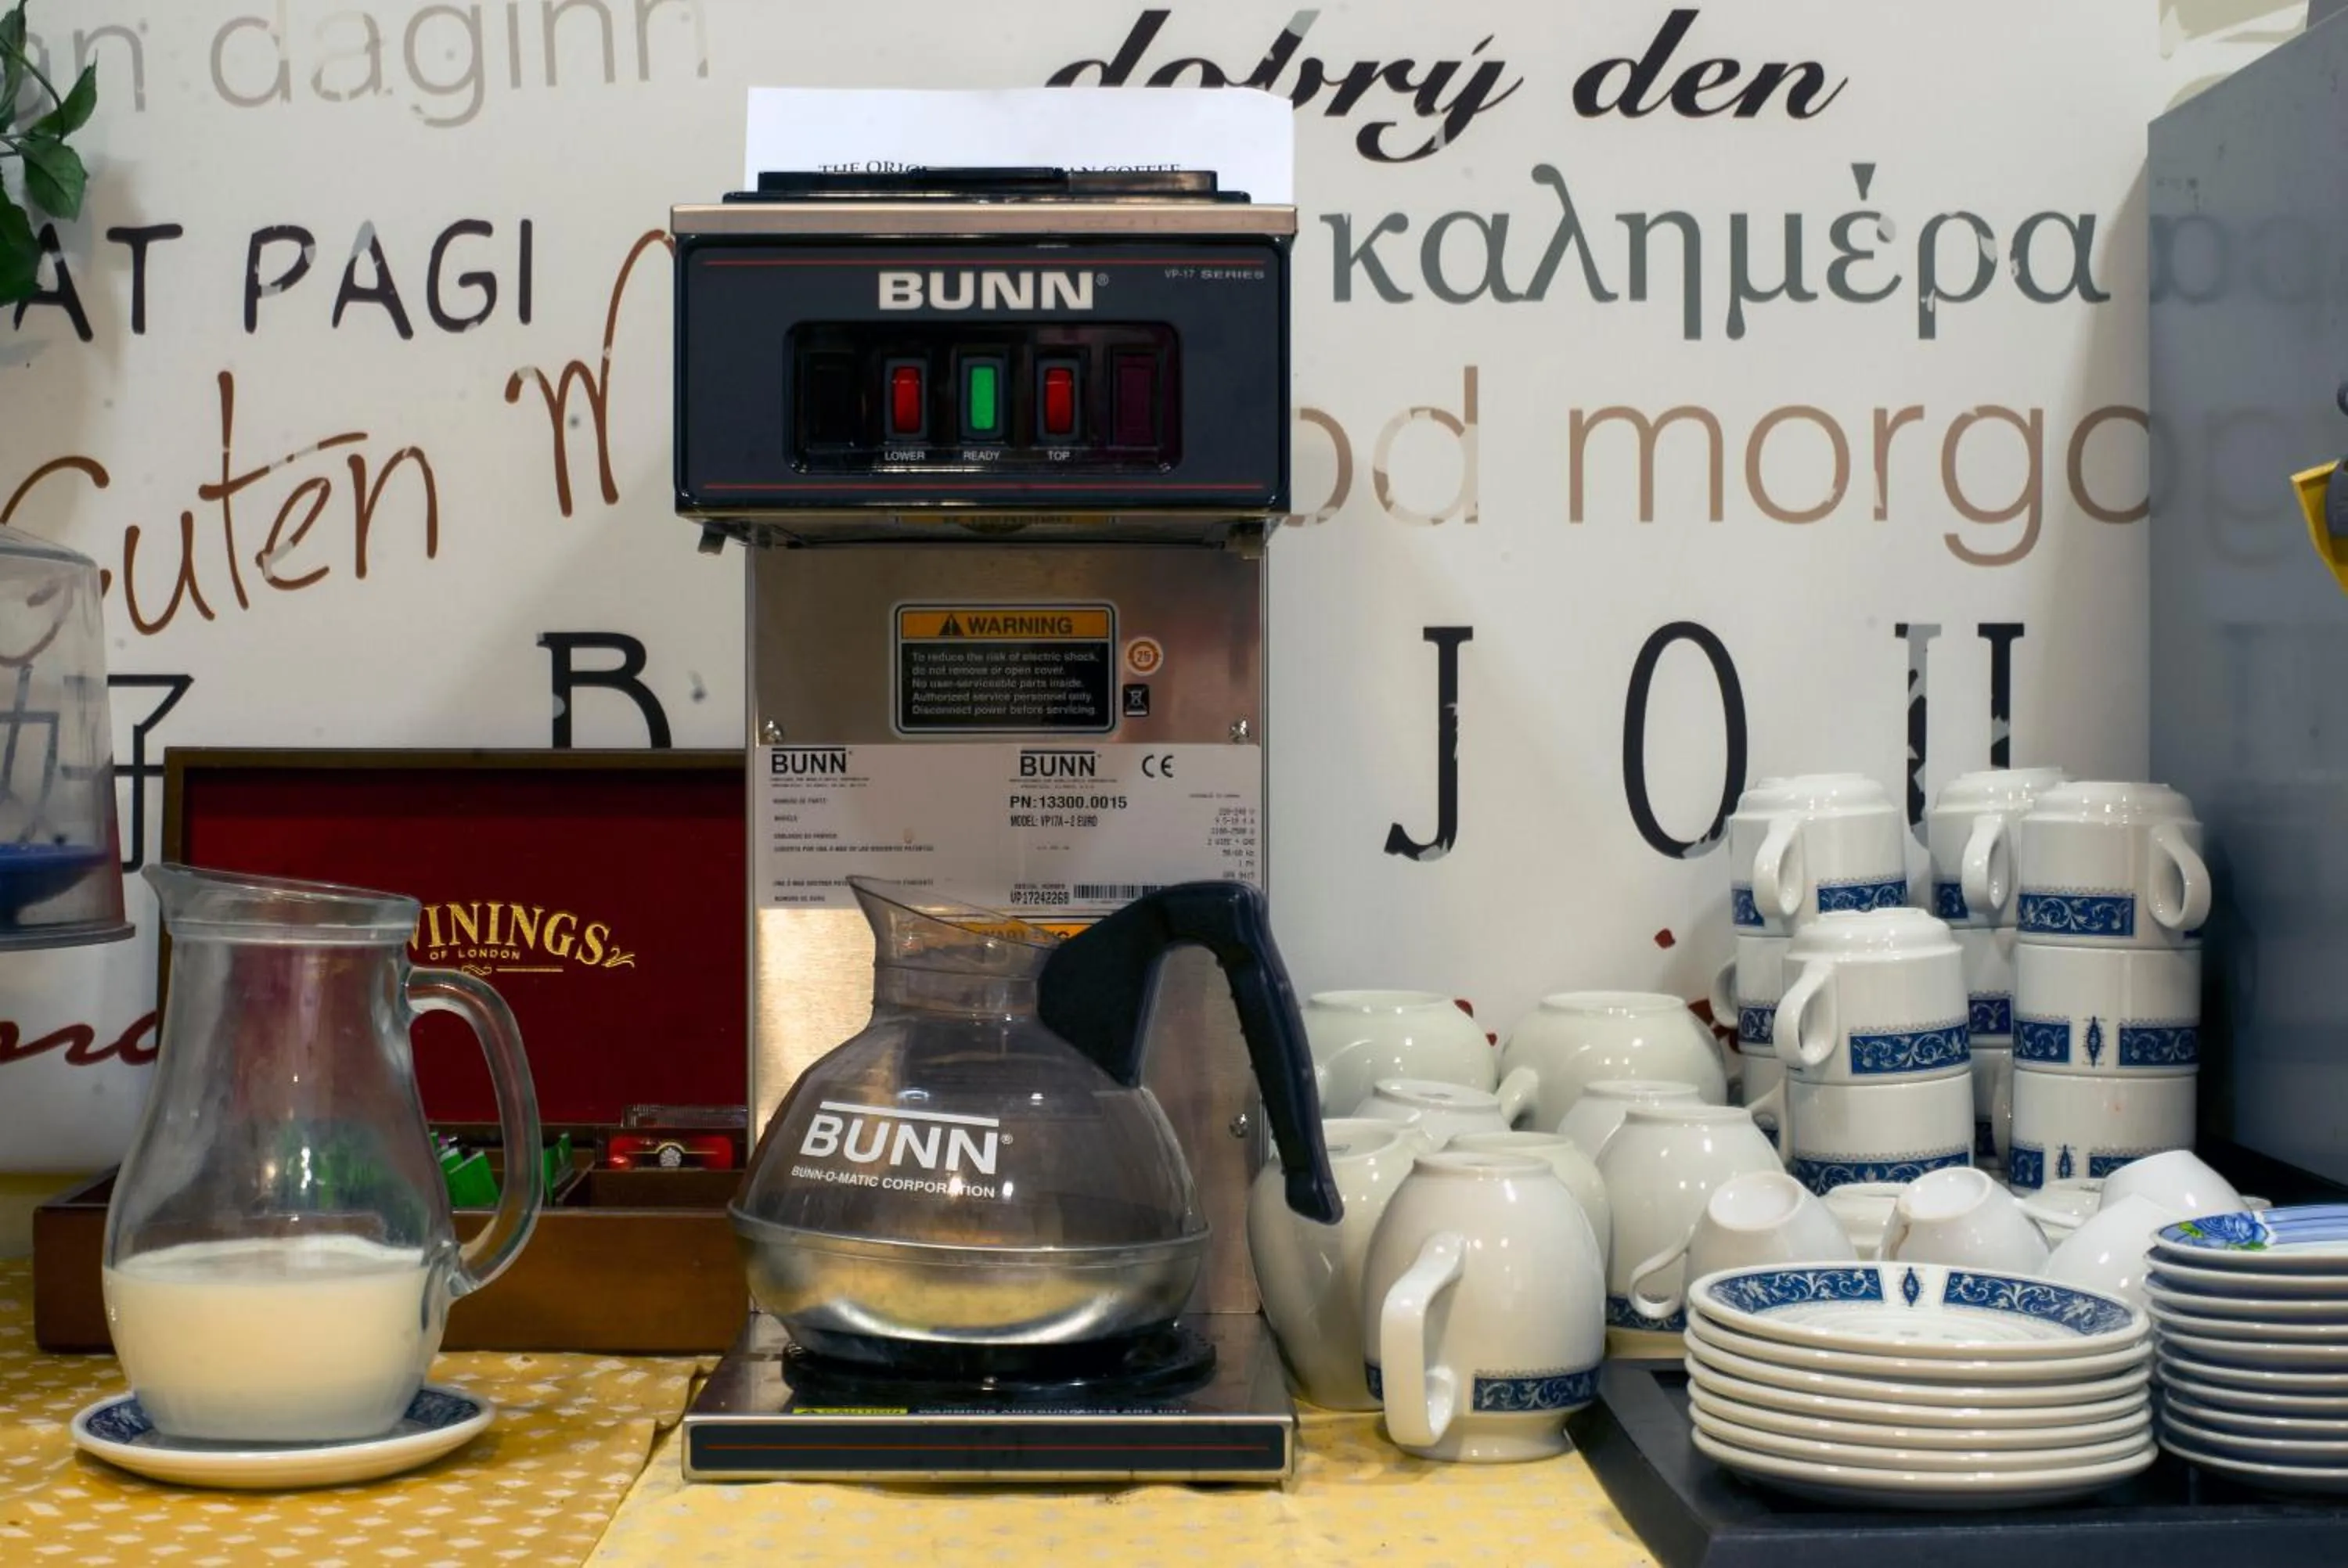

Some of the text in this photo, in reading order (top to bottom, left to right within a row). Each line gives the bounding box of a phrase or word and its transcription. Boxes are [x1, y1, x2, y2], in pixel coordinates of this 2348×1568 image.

[1572, 9, 1848, 119] den
[1320, 163, 2111, 340] καλημέρα
[243, 219, 533, 340] PAGI
[1165, 269, 1265, 279] VP-17 SERIES
[884, 451, 925, 461] LOWER
[963, 451, 1000, 461] READY
[1047, 451, 1071, 461] TOP
[967, 617, 1073, 635] WARNING
[927, 652, 964, 662] reduce
[967, 652, 984, 662] the
[986, 652, 1006, 662] risk
[1009, 652, 1019, 662] of
[928, 665, 945, 675] not
[949, 665, 988, 675] remove
[1004, 665, 1031, 675] open
[1019, 678, 1047, 689] parts
[973, 692, 1010, 701] service
[974, 705, 1007, 715] power
[1010, 705, 1043, 715] before
[771, 753, 847, 774] BUNN
[1020, 755, 1095, 776] BUNN
[1010, 796, 1127, 809] PN:13300.0015
[410, 901, 611, 965] ININGS
[429, 948, 520, 961] OF LONDON
[791, 1165, 878, 1188] BUNN-O-MATIC
